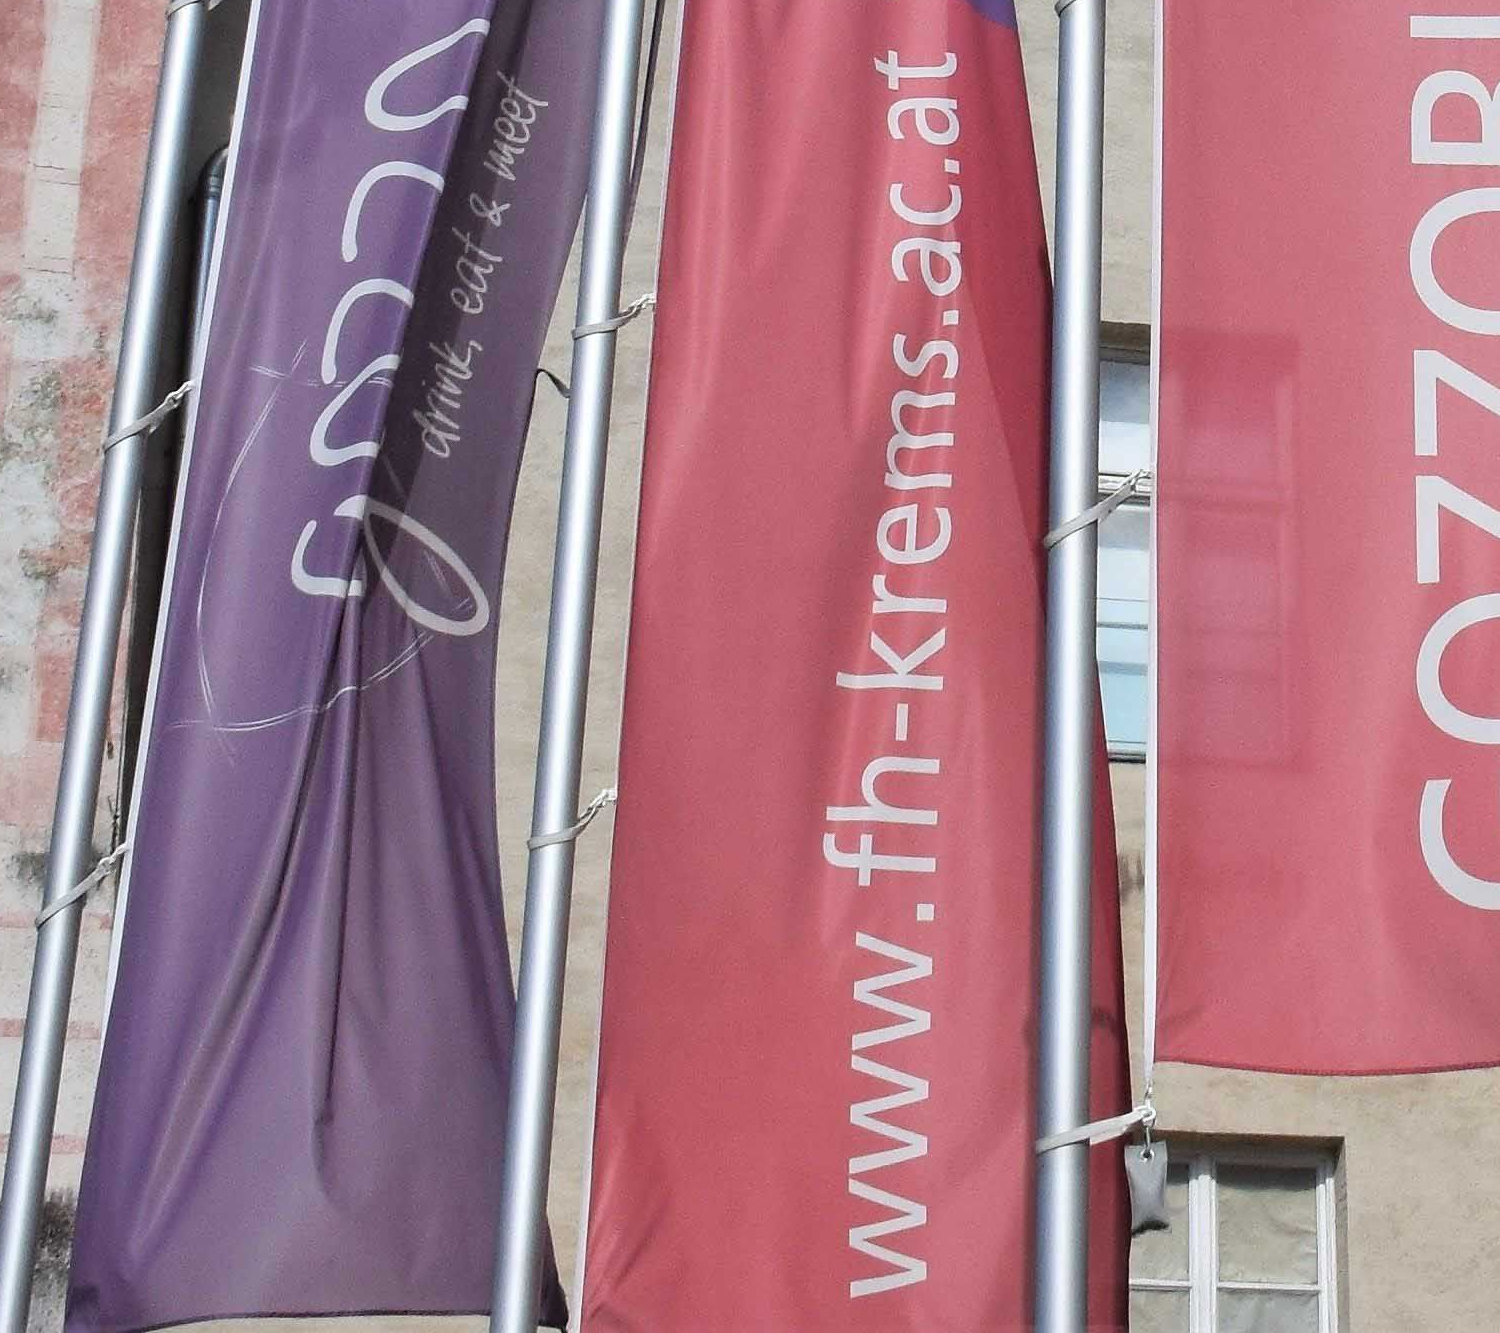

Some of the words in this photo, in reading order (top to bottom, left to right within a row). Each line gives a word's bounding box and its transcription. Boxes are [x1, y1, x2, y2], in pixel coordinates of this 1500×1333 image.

[484, 69, 549, 183] meet
[469, 192, 511, 226] &
[450, 224, 504, 315] eat
[413, 336, 482, 460] drink,
[823, 49, 965, 1299] www.fh-krems.ac.at
